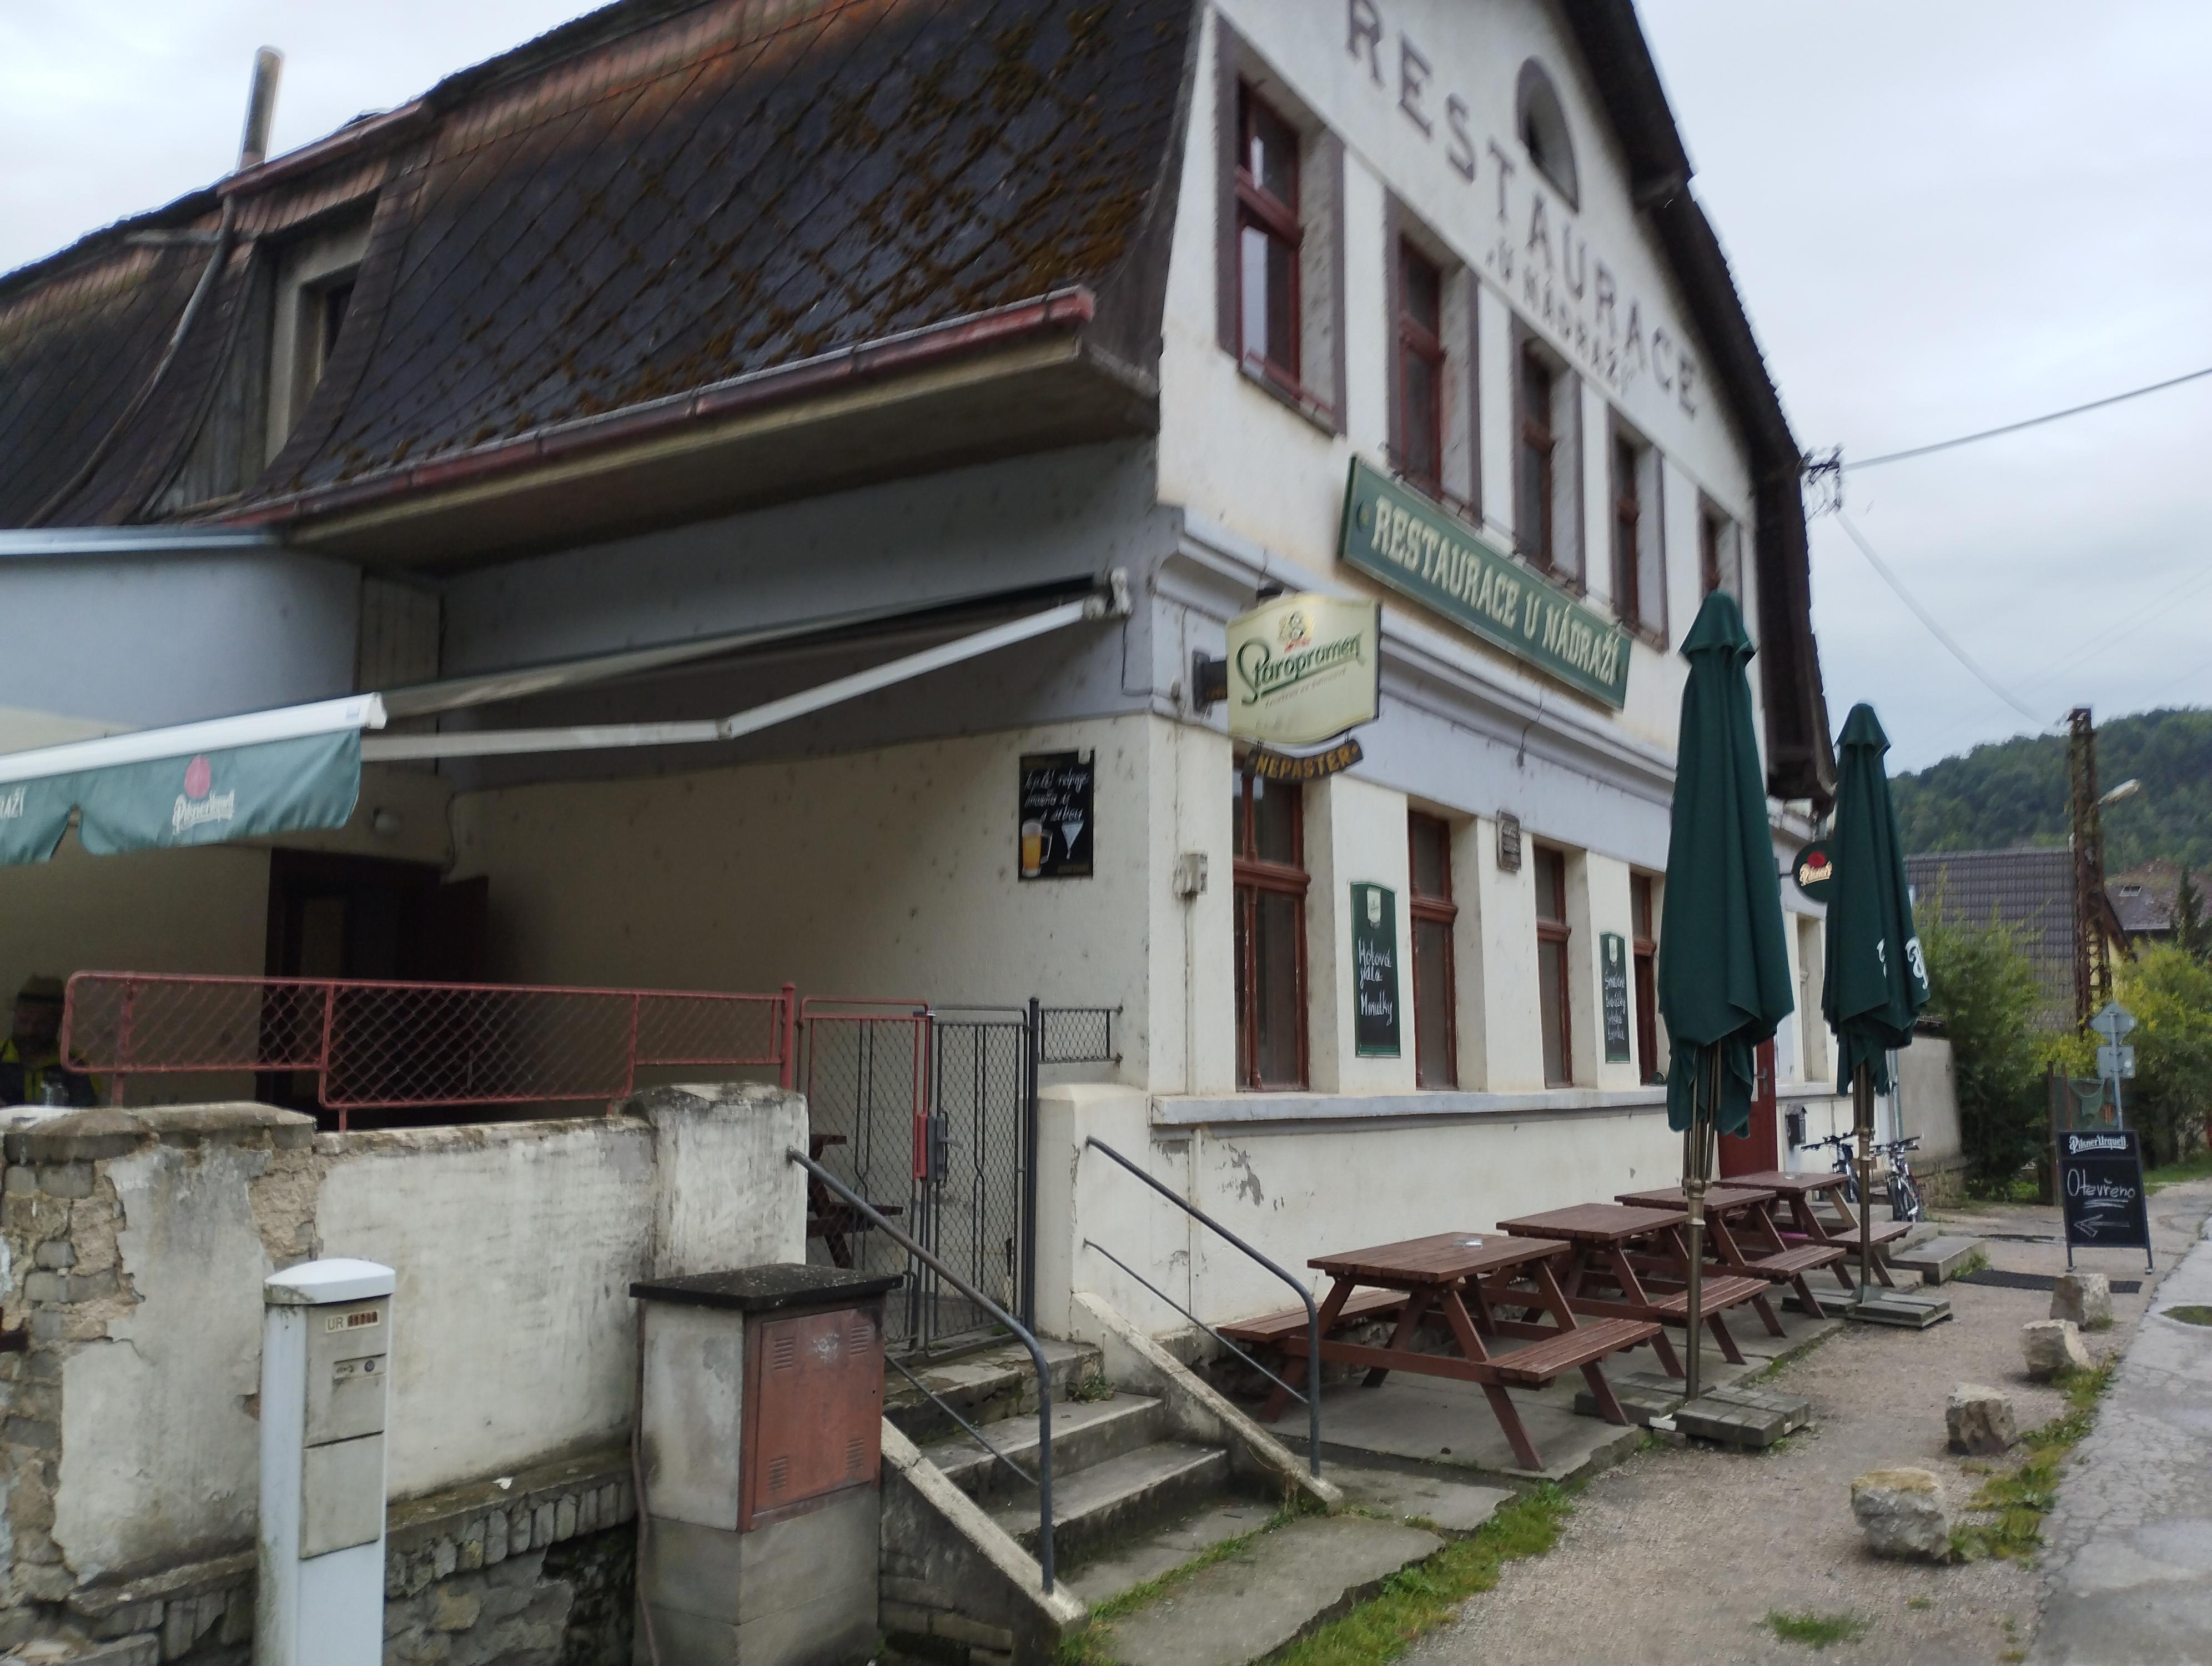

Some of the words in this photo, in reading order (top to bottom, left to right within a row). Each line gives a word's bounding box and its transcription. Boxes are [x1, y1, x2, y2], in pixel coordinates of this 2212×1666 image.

[1344, 0, 1697, 420] RESTAURACE
[1370, 493, 1521, 630] RESTAURACE
[1524, 590, 1542, 640] U
[1541, 601, 1622, 686] NÁDRAŽÍ
[1236, 631, 1364, 706] Staropramen
[1358, 937, 1392, 967] Hotová
[1360, 989, 1393, 1026] Minutky
[2069, 1135, 2098, 1155] Pilsner
[2096, 1133, 2128, 1150] Urquell
[2067, 1168, 2135, 1198] Otevřeno
